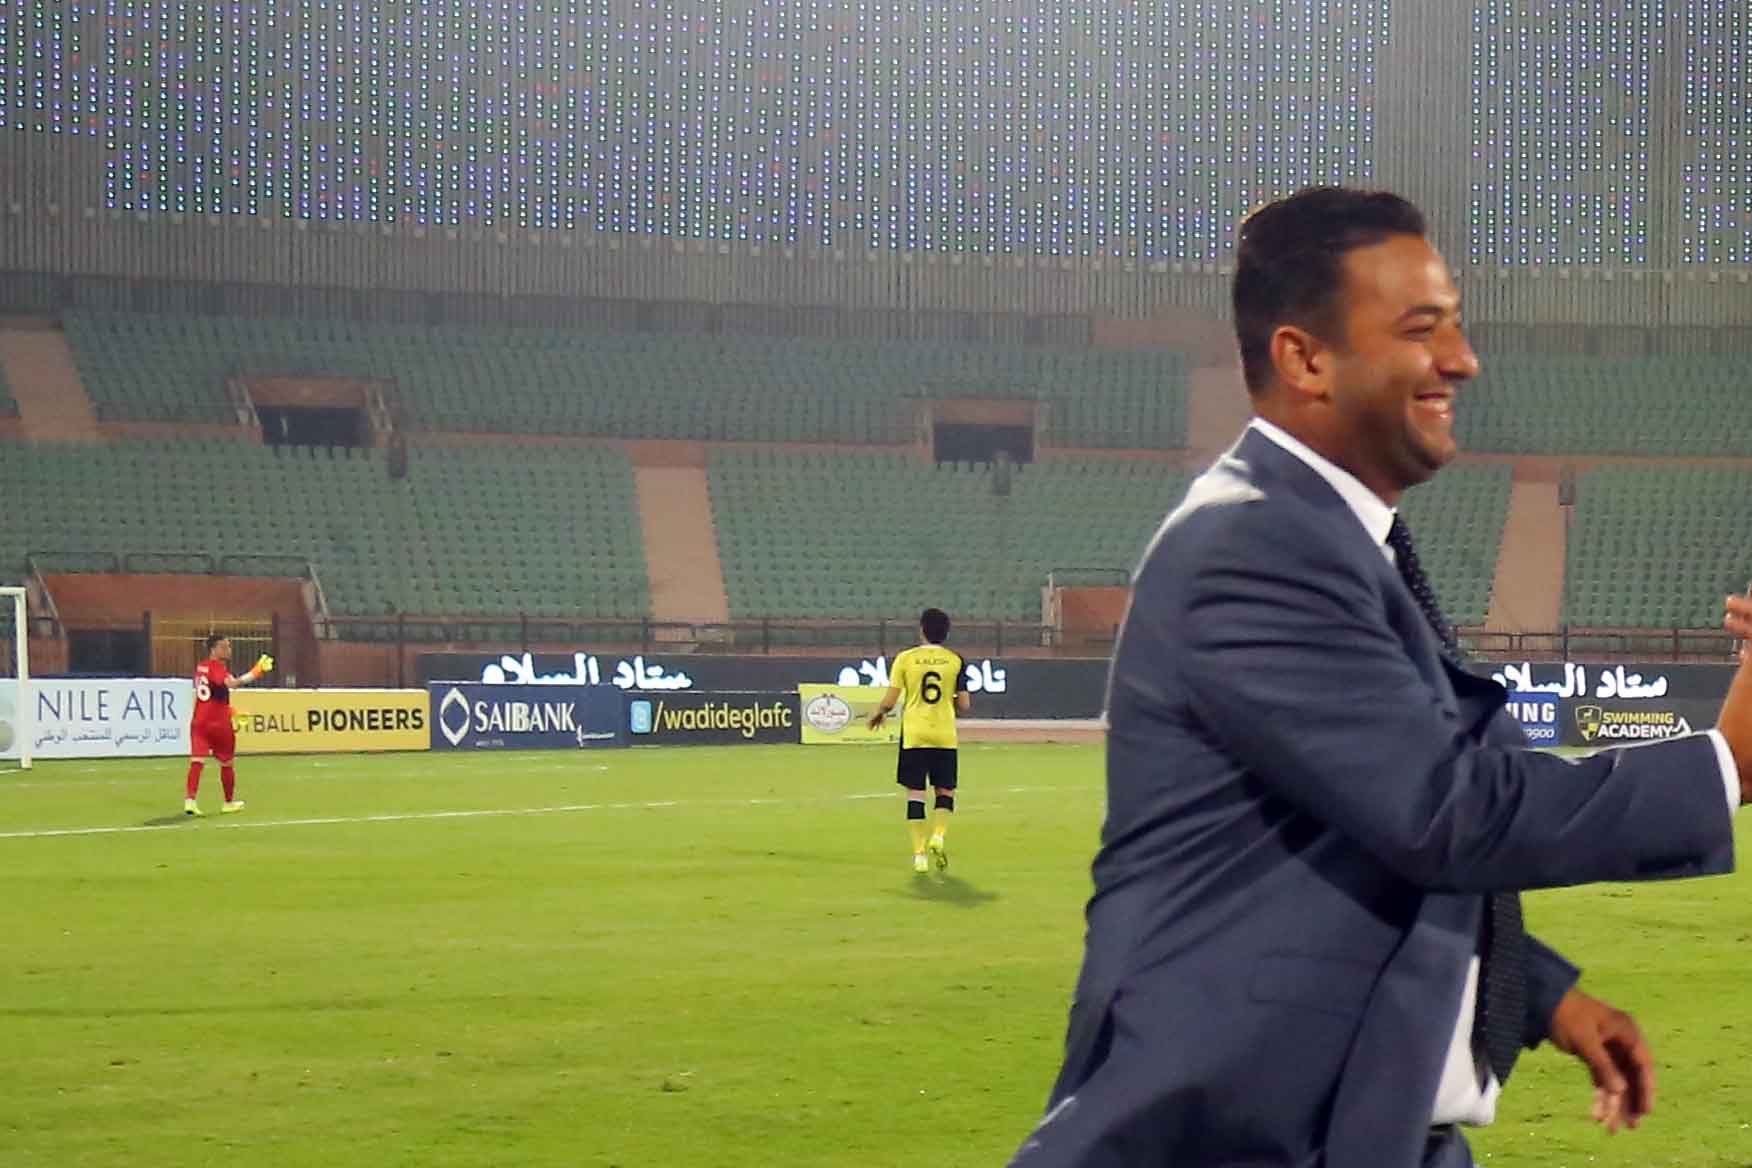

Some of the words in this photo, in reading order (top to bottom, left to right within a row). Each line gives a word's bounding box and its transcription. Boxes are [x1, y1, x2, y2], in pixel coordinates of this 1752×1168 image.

[483, 653, 600, 685] السلام
[612, 656, 692, 690] ستاد
[1596, 665, 1668, 698] ستاد
[921, 672, 942, 704] 6
[38, 690, 110, 721] NILE
[122, 690, 177, 721] AIR
[307, 708, 424, 732] PIONEERS
[474, 701, 577, 733] SAIBANK
[1603, 712, 1674, 725] SWIMMING
[1598, 724, 1673, 738] ACADEMY
